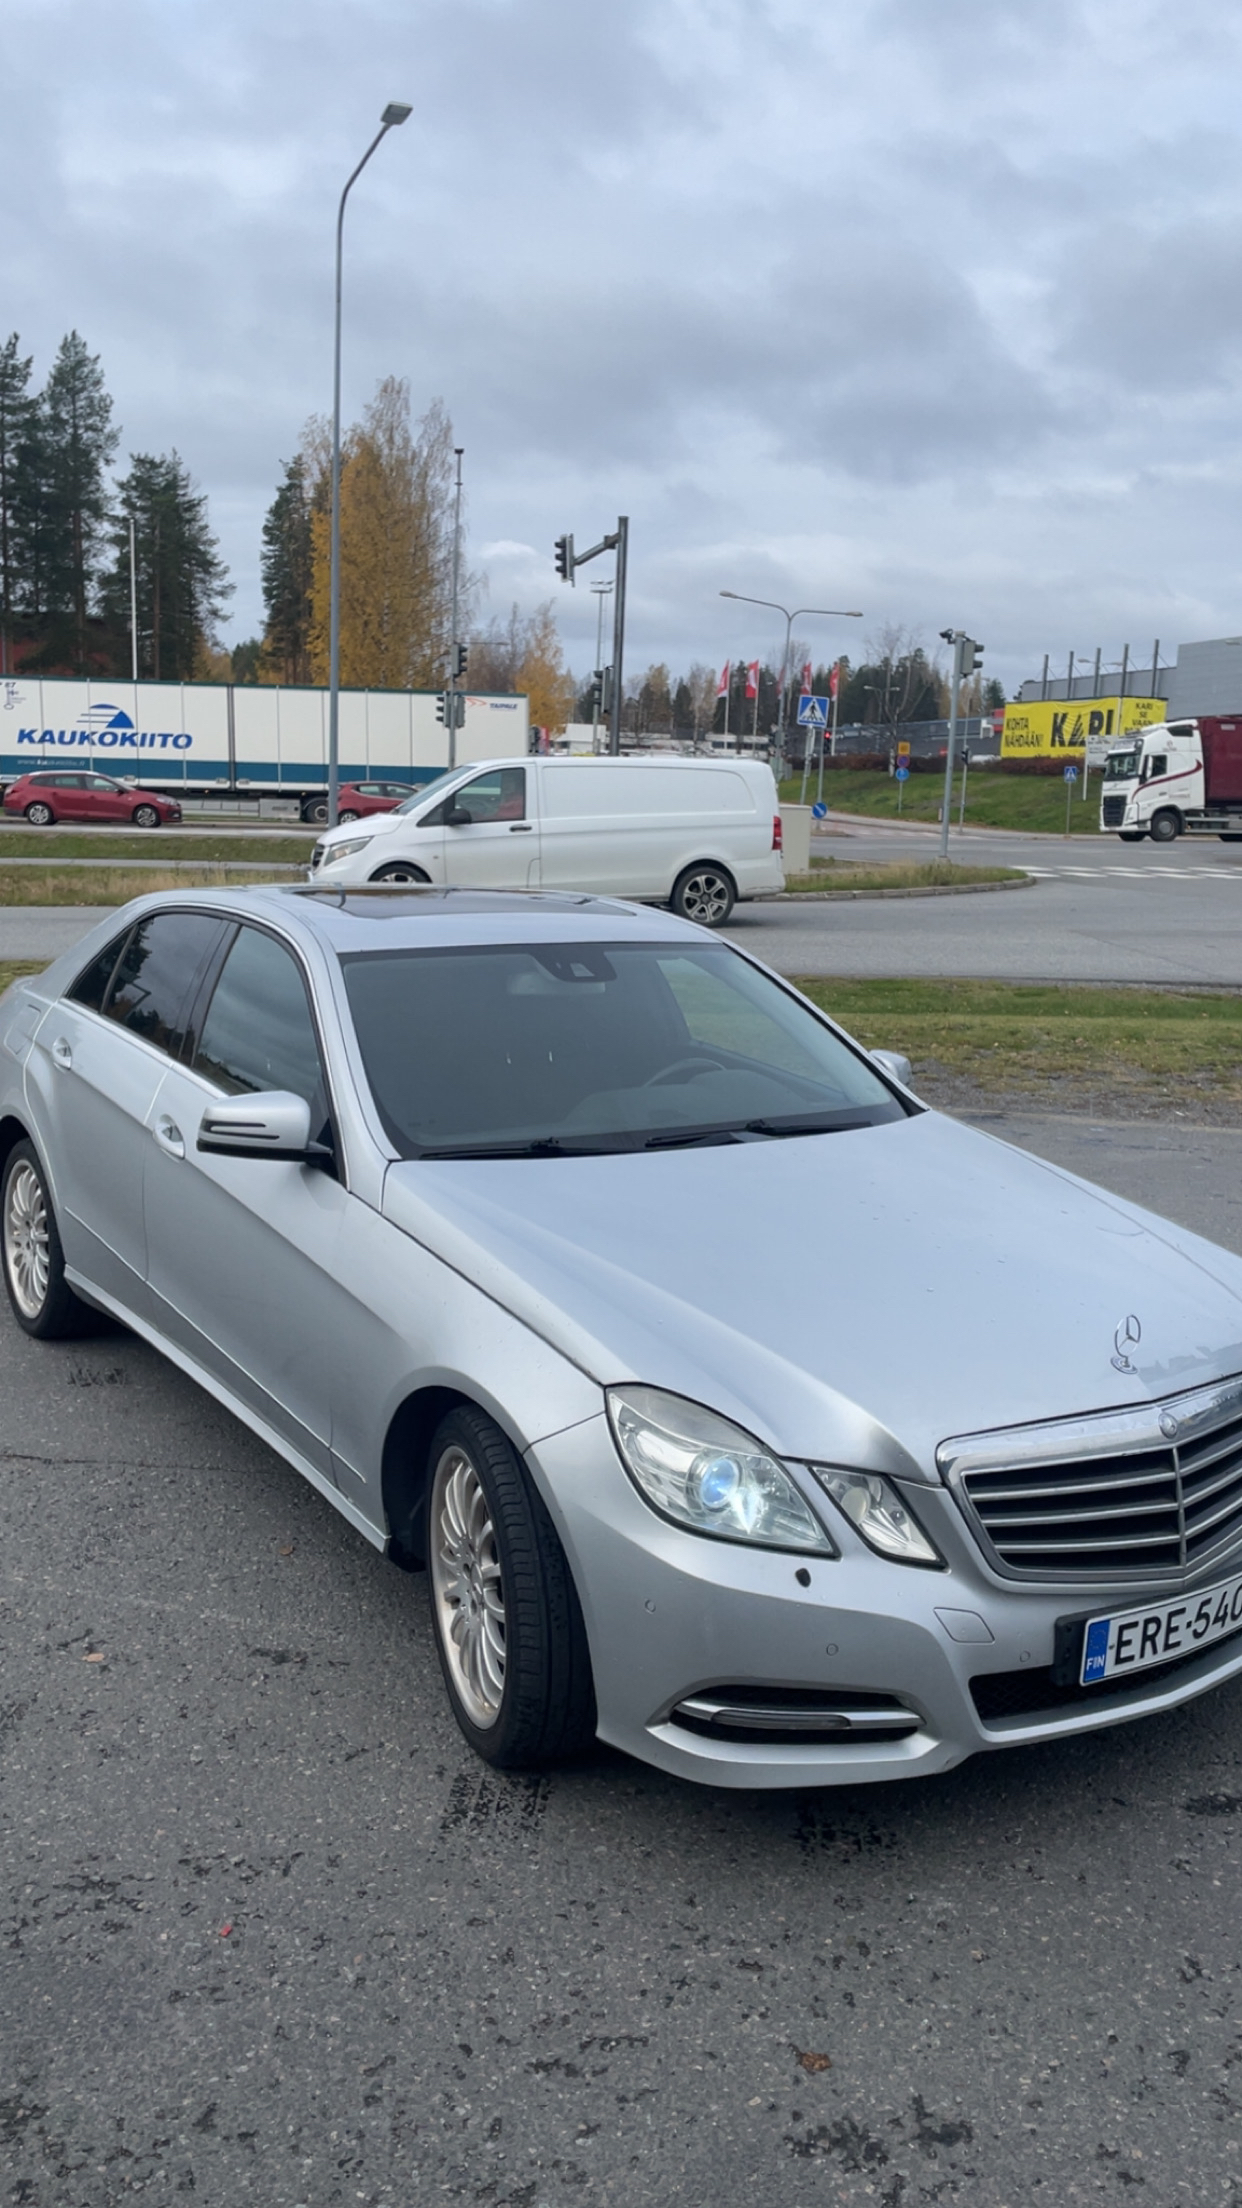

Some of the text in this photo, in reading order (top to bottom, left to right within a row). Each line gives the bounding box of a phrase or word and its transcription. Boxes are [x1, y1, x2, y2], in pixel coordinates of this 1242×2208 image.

[1006, 717, 1029, 730] KOHTA
[17, 729, 193, 750] KAUKOKIITO
[1114, 1583, 1242, 1666] ERE-540
[1086, 1655, 1105, 1671] FIN
